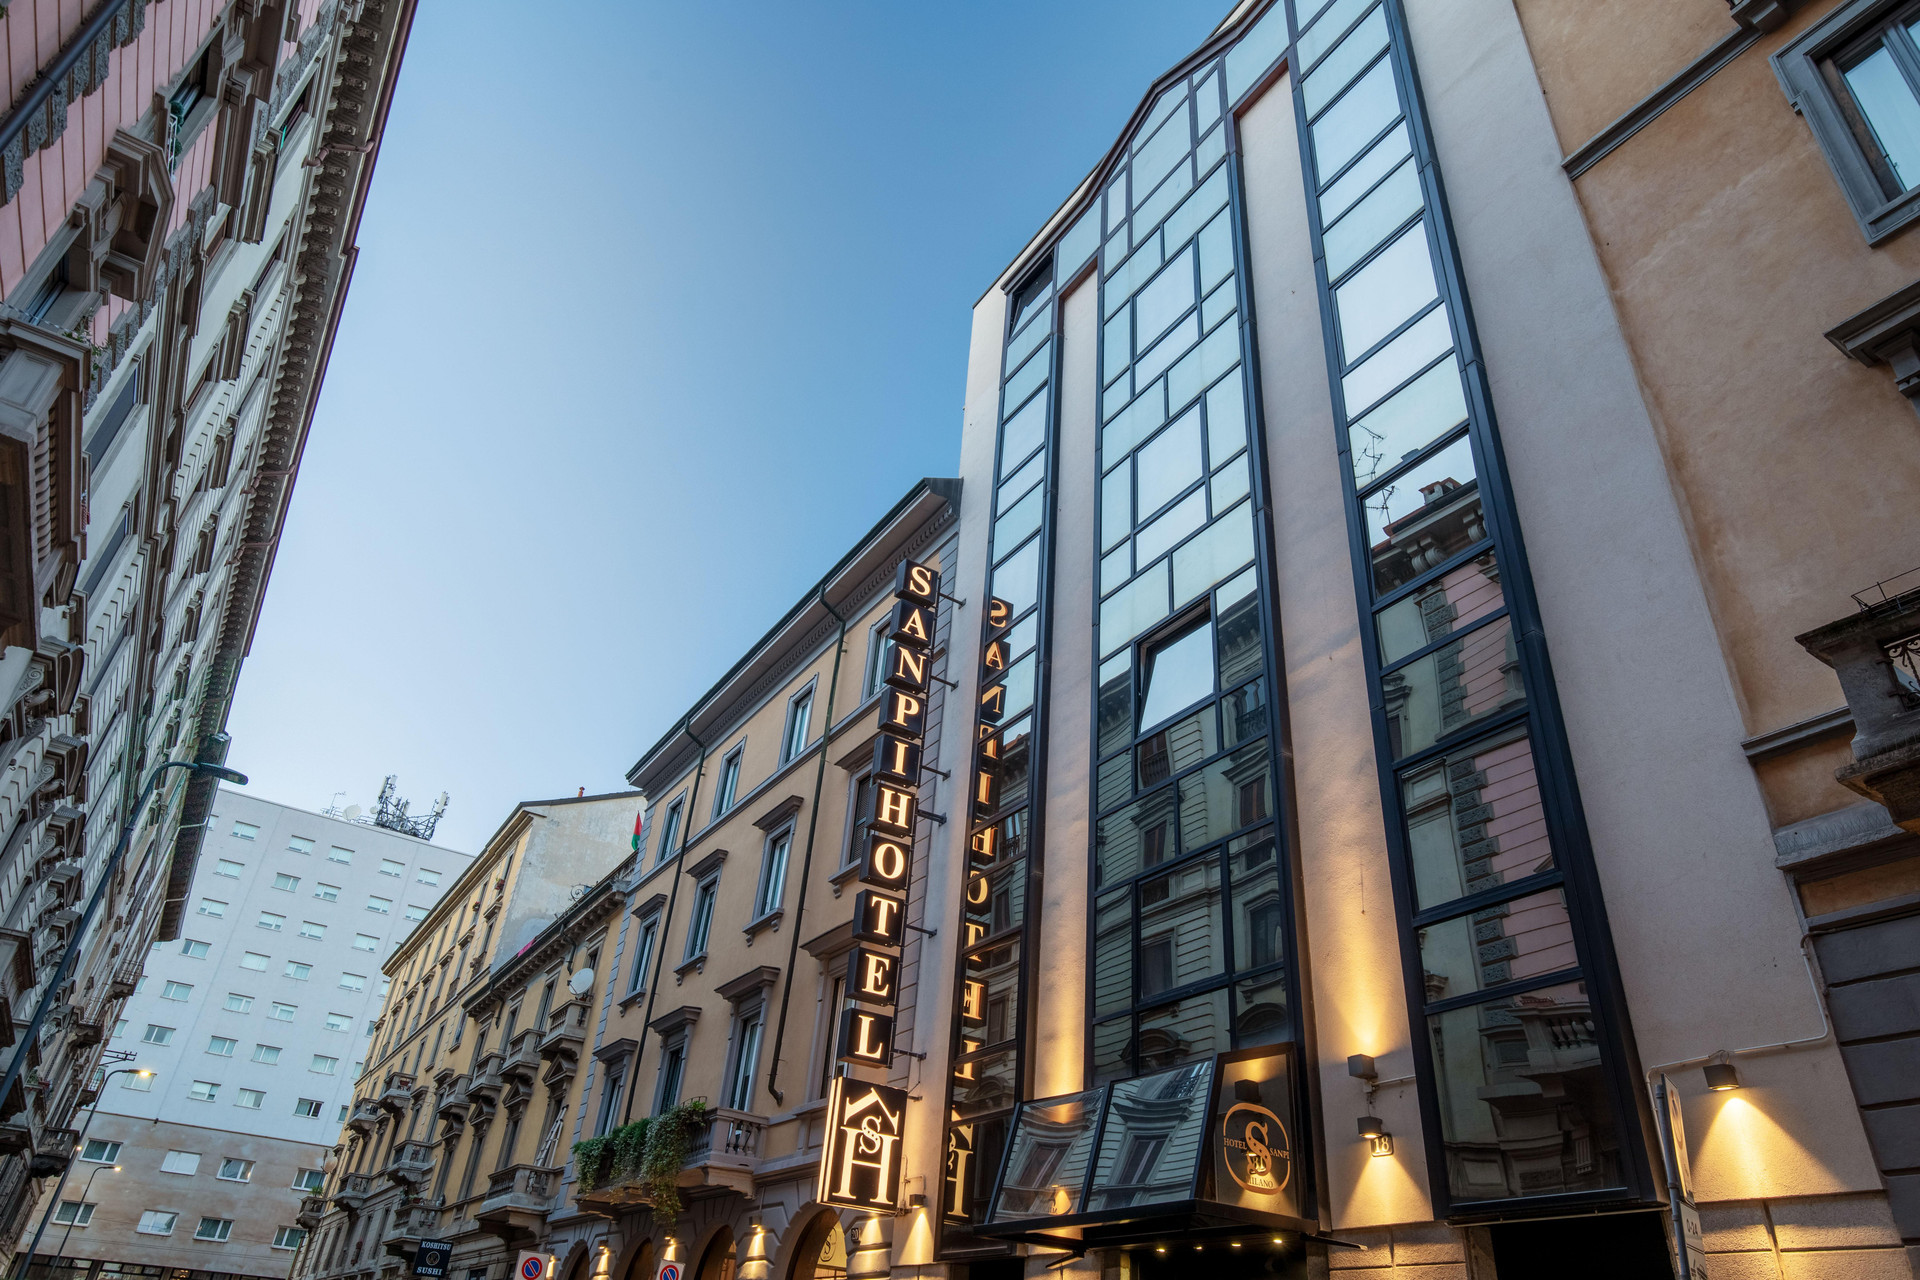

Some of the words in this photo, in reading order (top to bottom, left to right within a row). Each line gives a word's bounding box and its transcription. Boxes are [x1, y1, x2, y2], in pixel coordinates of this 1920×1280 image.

[1224, 1137, 1248, 1150] HOTEL
[1270, 1148, 1289, 1159] SANPI
[1374, 1136, 1389, 1153] 18
[421, 1241, 452, 1250] KOSHITSU
[416, 1266, 443, 1275] SUSHI
